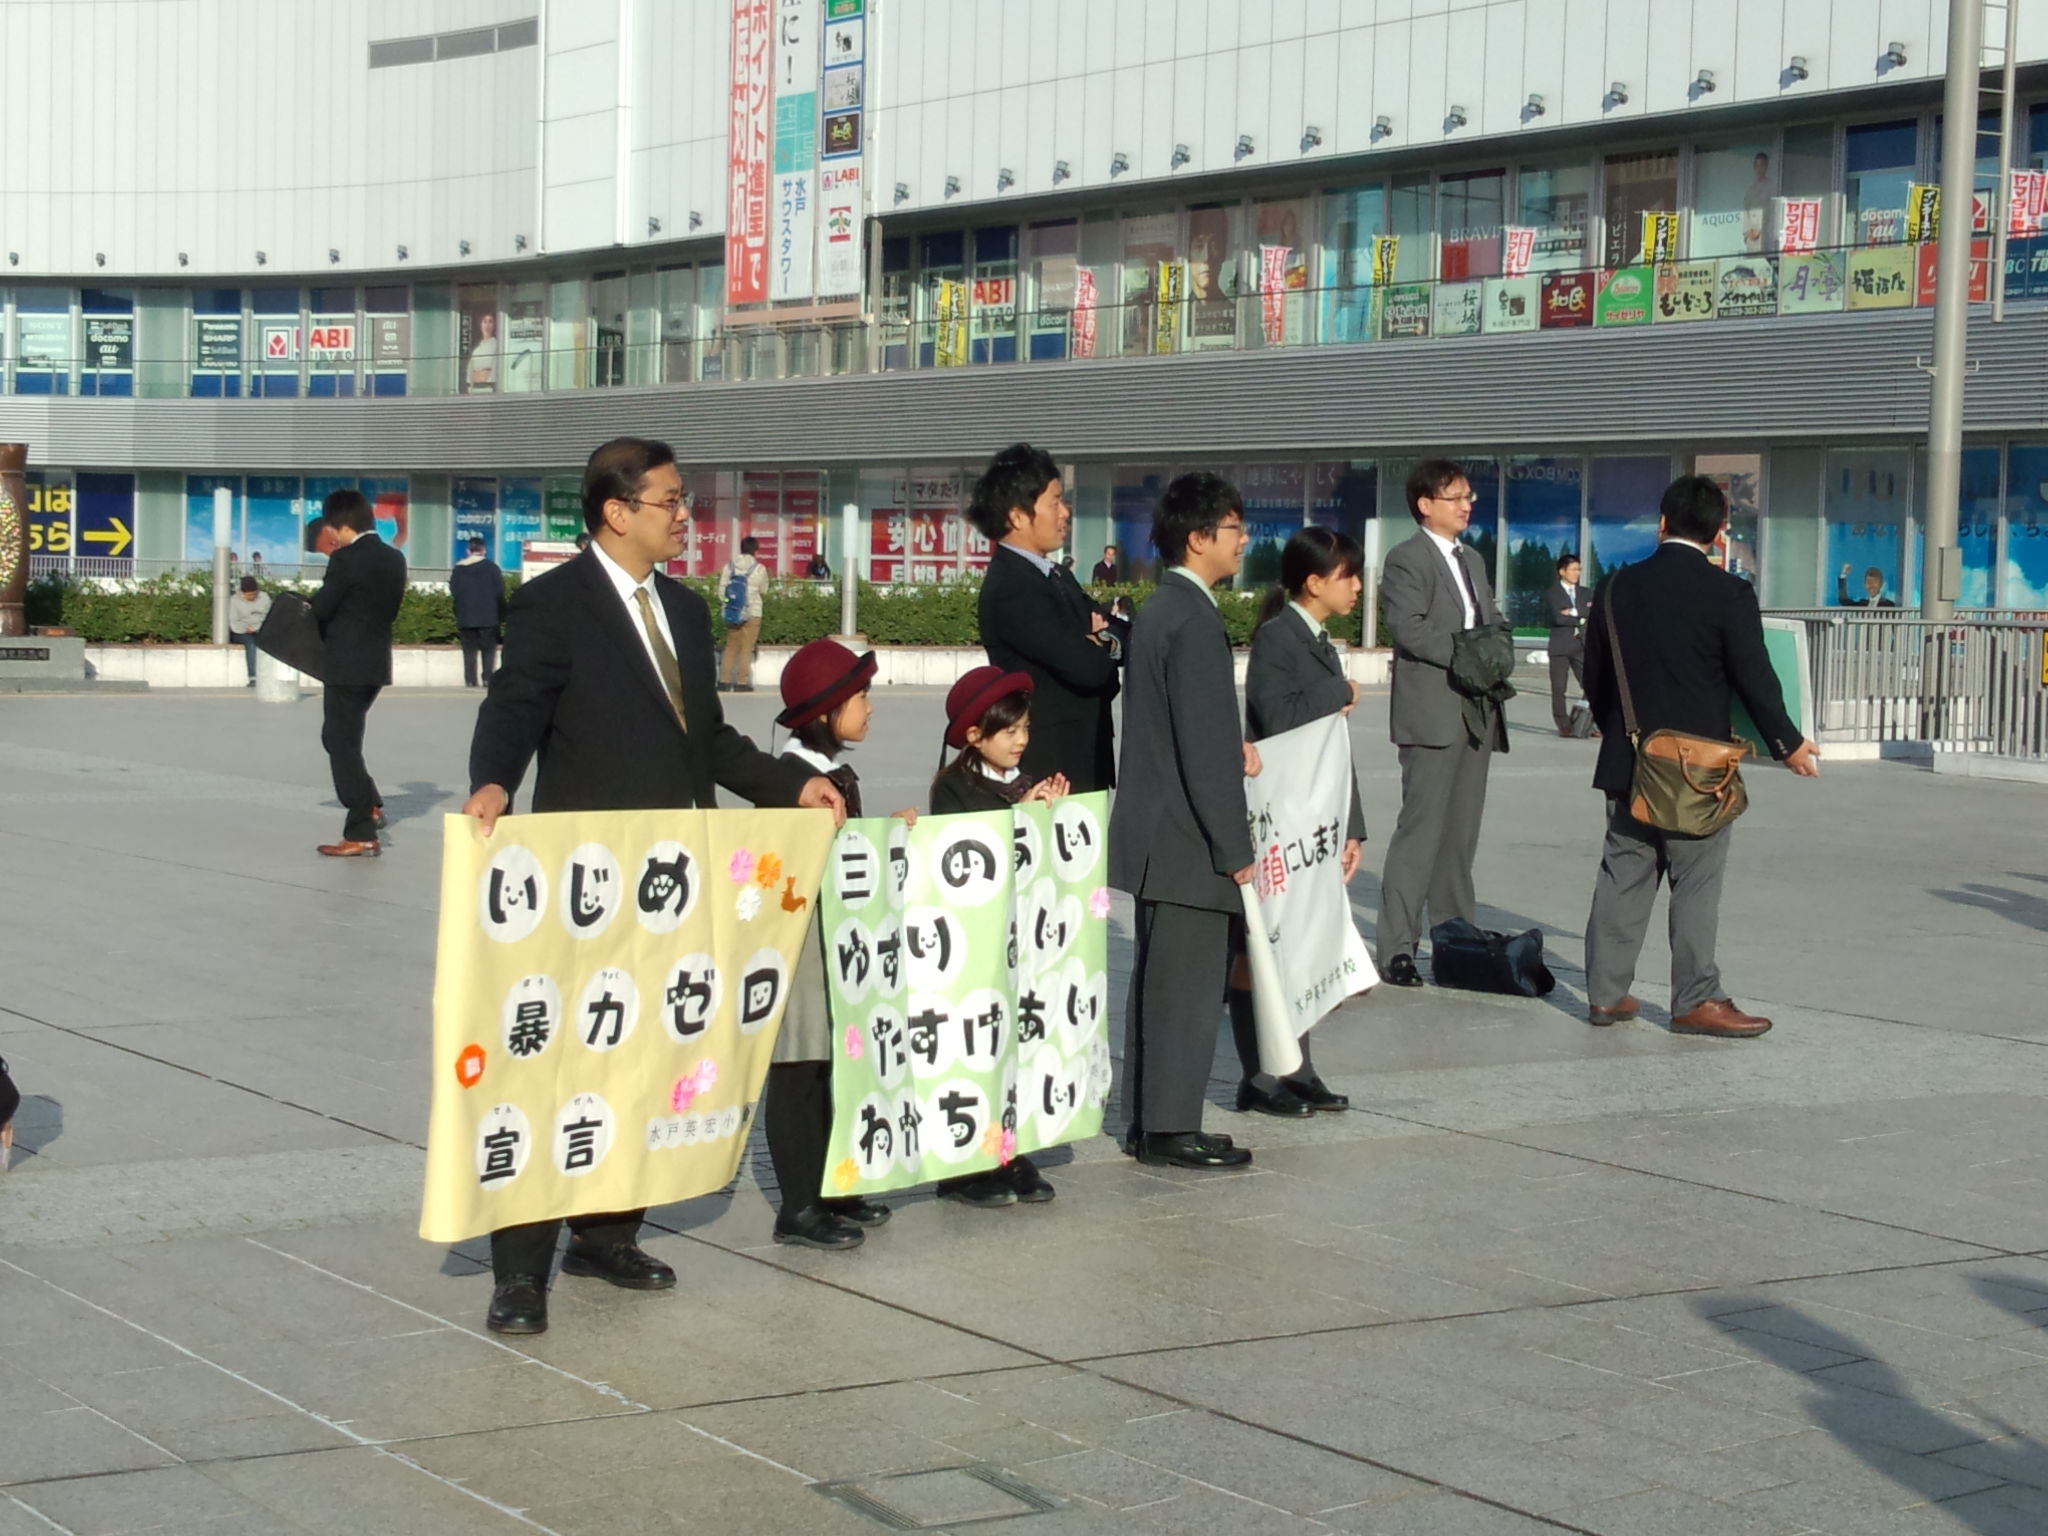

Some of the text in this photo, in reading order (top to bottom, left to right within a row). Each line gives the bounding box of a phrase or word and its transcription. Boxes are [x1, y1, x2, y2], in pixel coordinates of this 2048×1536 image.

[834, 168, 859, 182] LABI
[795, 176, 807, 216] 水戸
[1702, 213, 1741, 226] AQUOS
[1874, 222, 1898, 237] au
[781, 178, 793, 294] サウスタワー
[90, 334, 129, 343] docomo
[99, 345, 119, 353] au
[488, 851, 691, 929] いじめ
[508, 967, 781, 1058] 暴力ゼロ
[479, 1115, 604, 1185] 宣言
